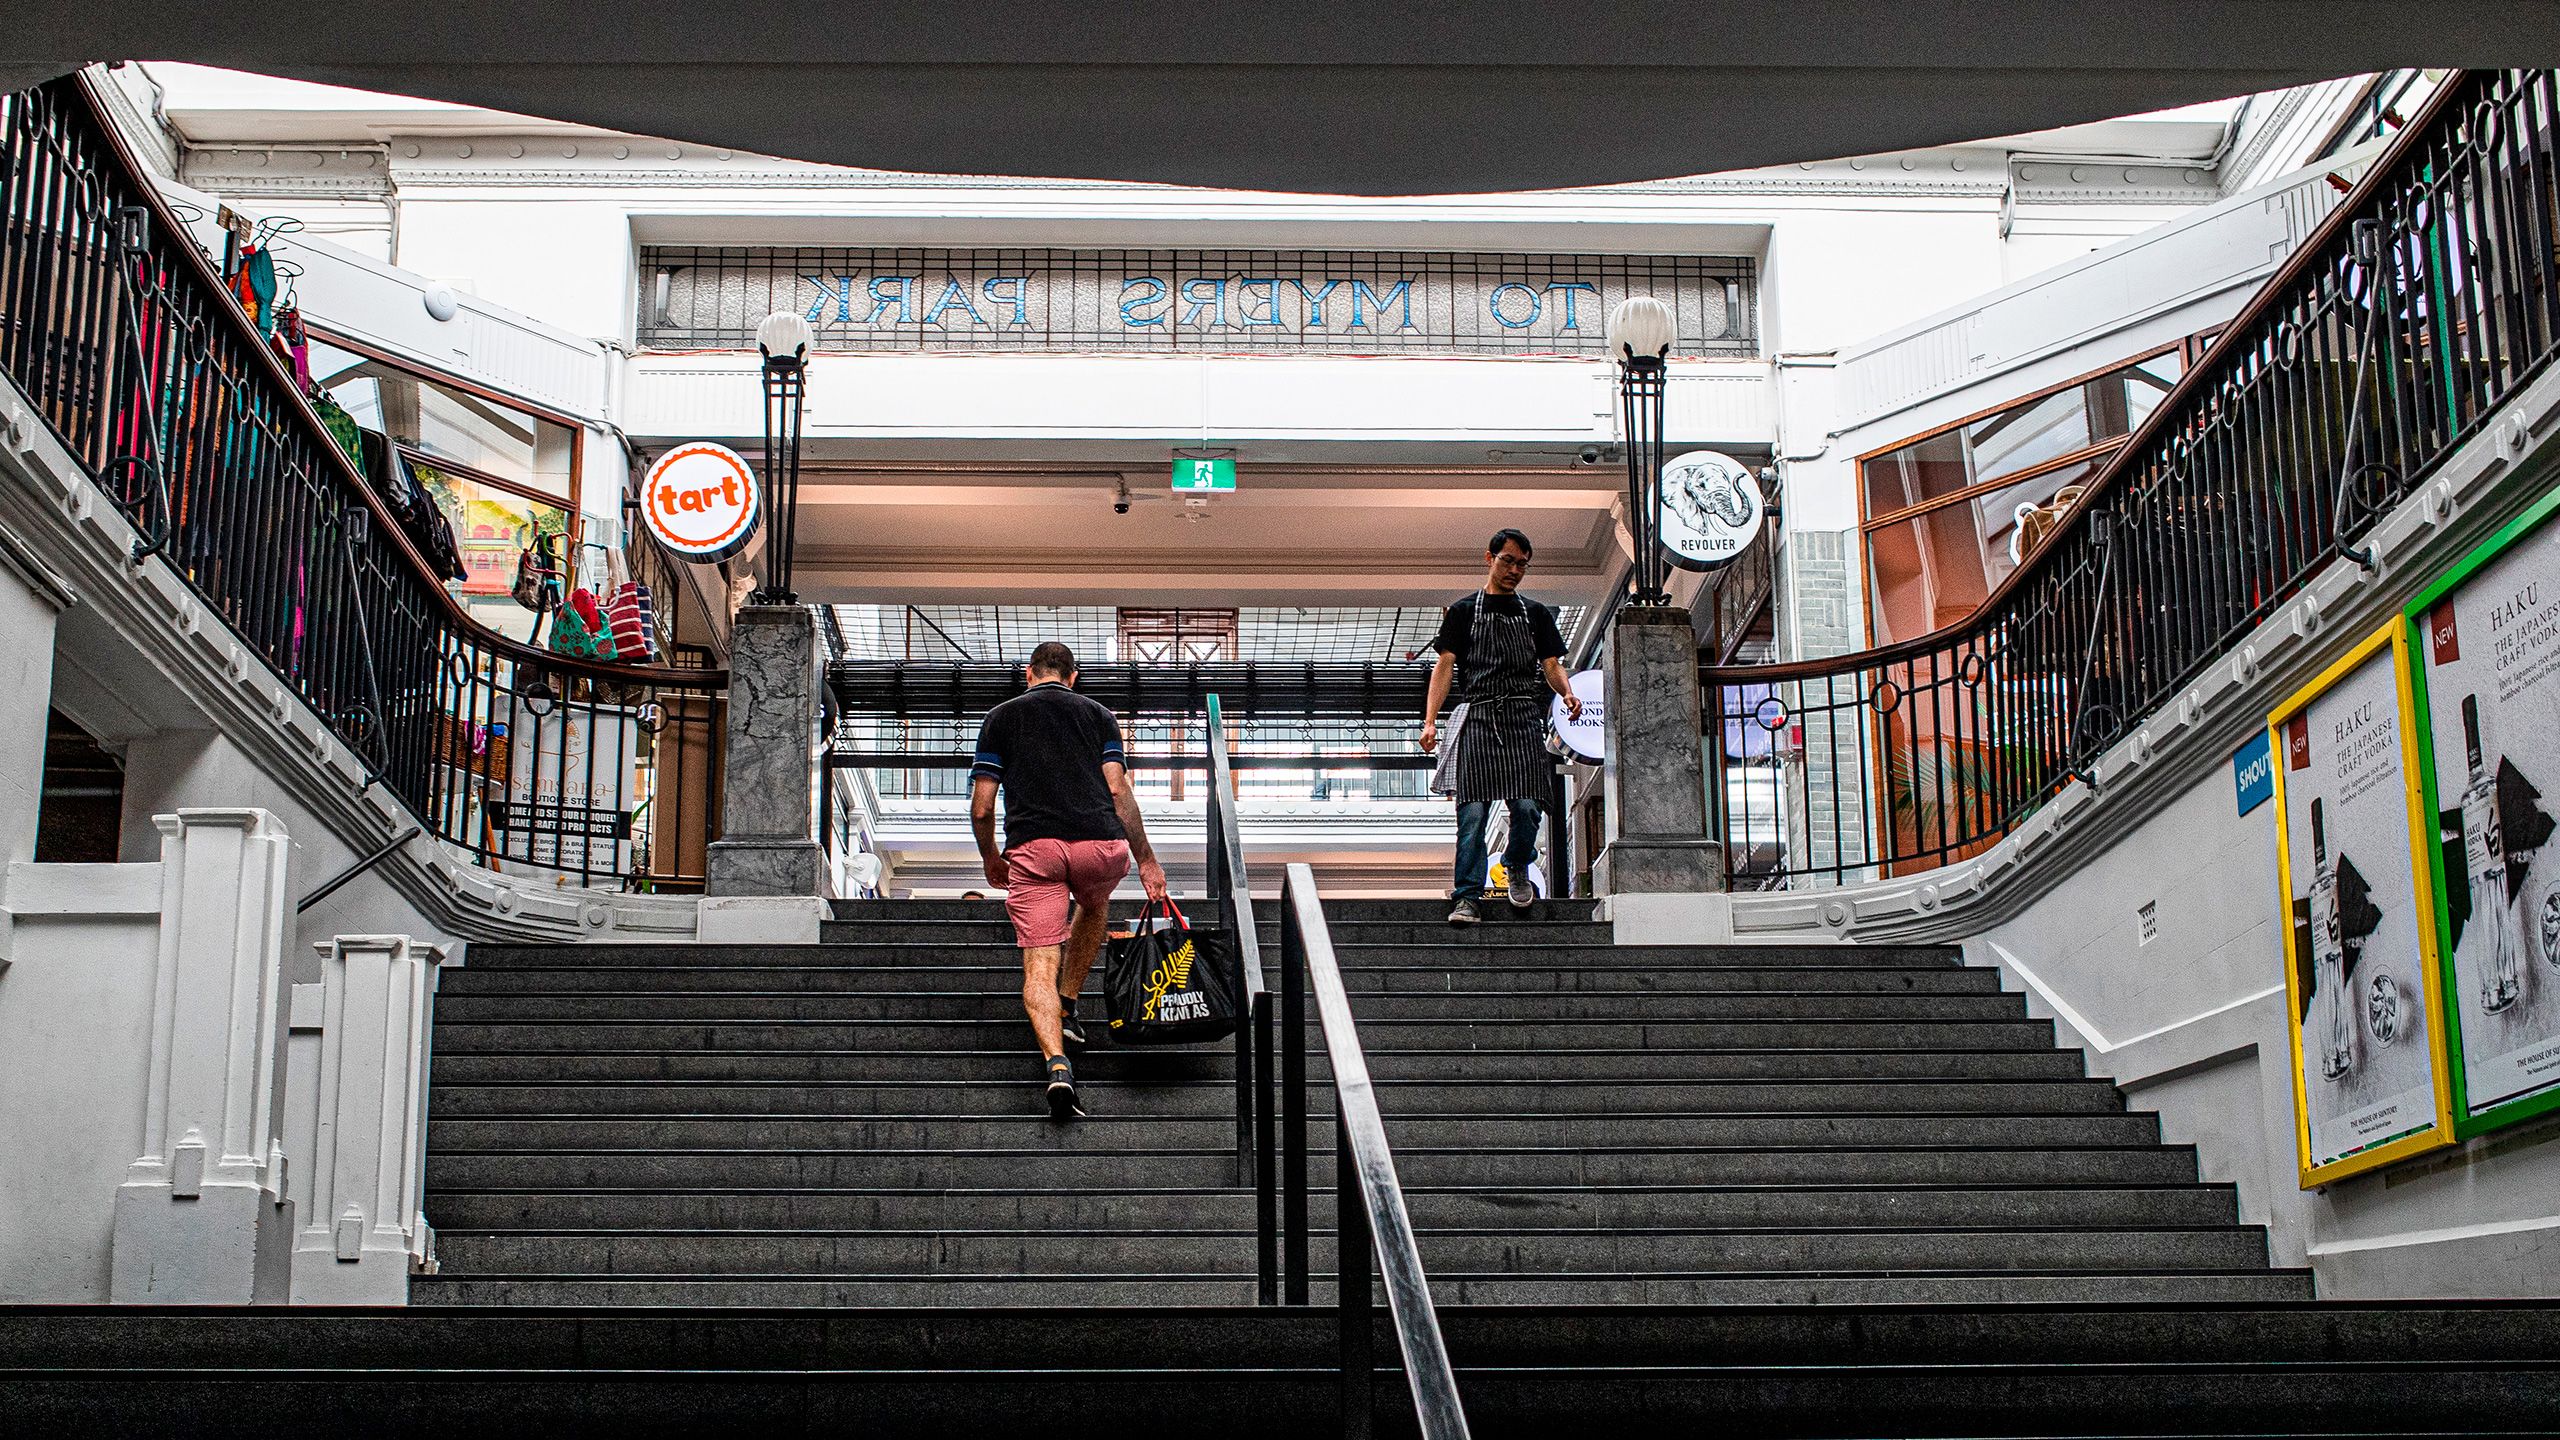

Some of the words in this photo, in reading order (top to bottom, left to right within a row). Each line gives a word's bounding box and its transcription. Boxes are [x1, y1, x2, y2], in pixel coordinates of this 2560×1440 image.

[658, 476, 740, 515] tart
[1681, 540, 1736, 551] REVOLVER
[2491, 582, 2538, 631] HAKU
[2435, 622, 2454, 649] NEW
[2495, 633, 2513, 656] THE
[2496, 642, 2527, 671] CRAFT
[2530, 621, 2560, 649] VODK
[1560, 708, 1603, 716] SEOND
[2335, 701, 2372, 743] HAKU
[2291, 733, 2307, 756] NEW
[2337, 747, 2352, 764] THE
[2354, 718, 2393, 751] JAPANESE
[2337, 753, 2362, 779] CRAFT
[2364, 735, 2393, 761] VODKA
[522, 793, 570, 805] BOUTIQE
[562, 809, 579, 820] OUR
[568, 822, 612, 834] PROUCTS
[1193, 1003, 1210, 1019] AS
